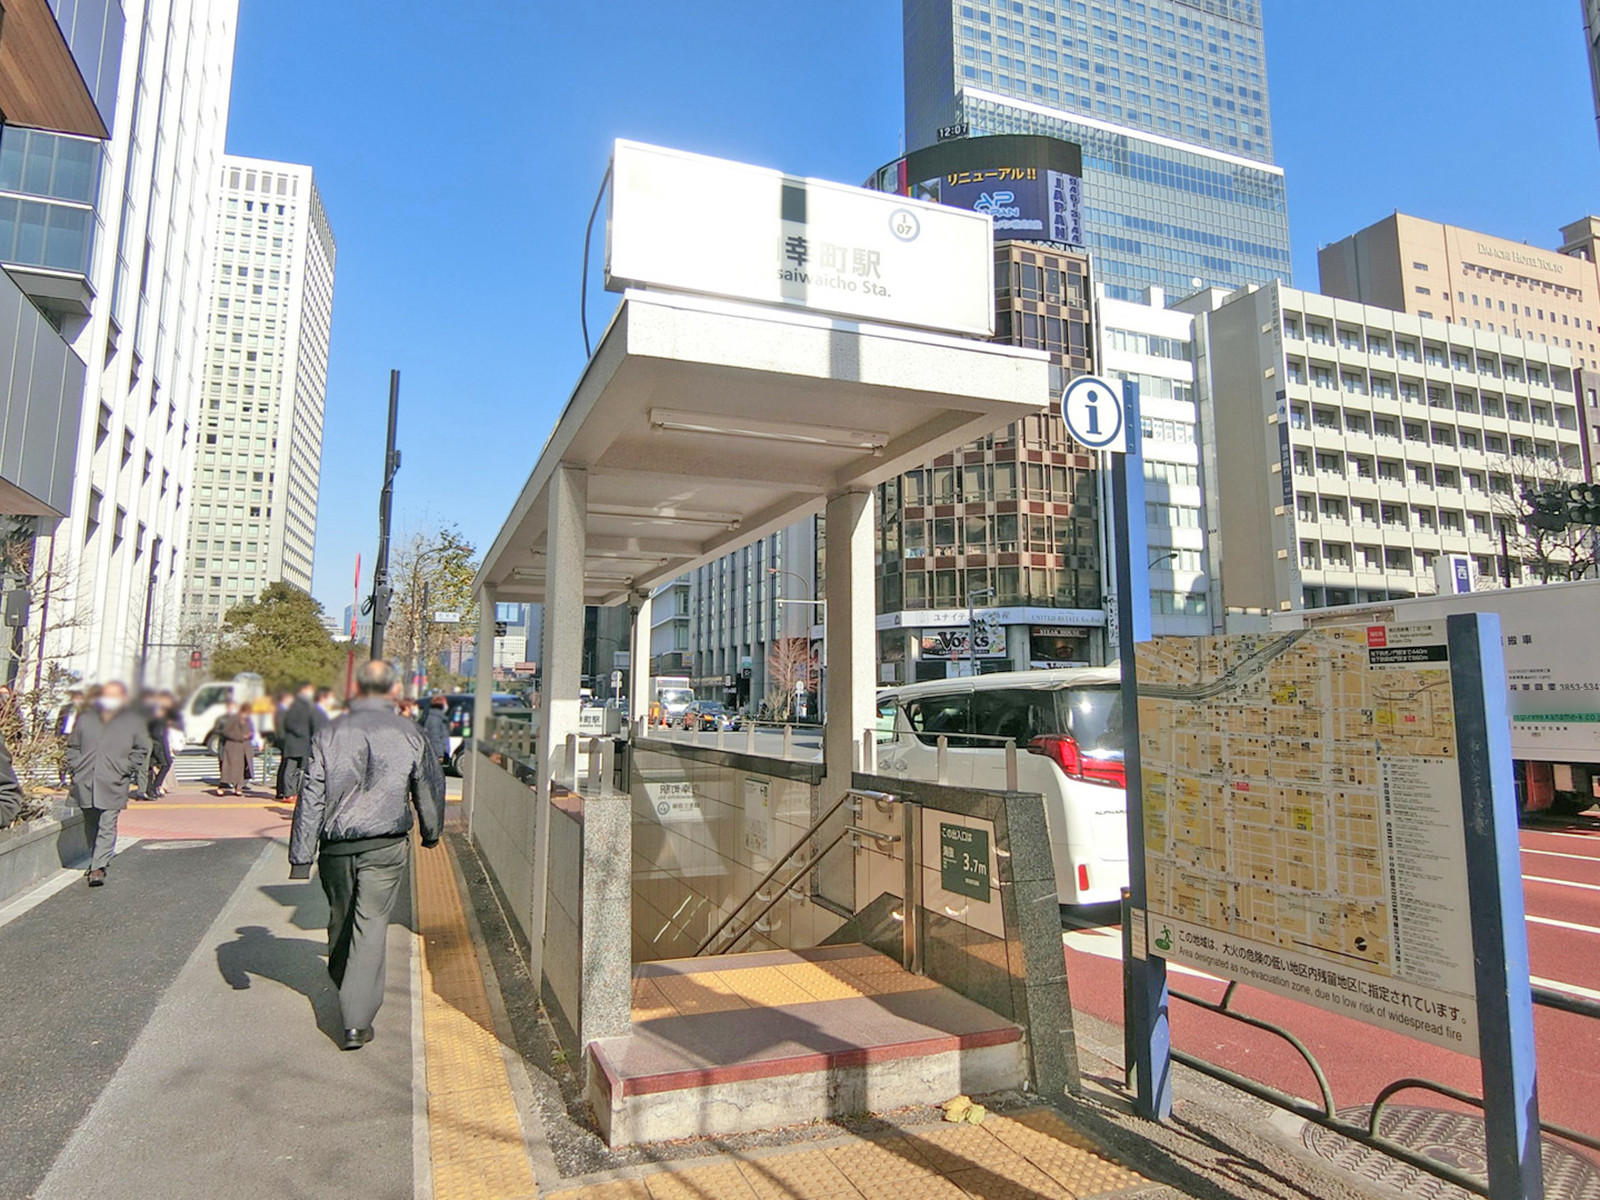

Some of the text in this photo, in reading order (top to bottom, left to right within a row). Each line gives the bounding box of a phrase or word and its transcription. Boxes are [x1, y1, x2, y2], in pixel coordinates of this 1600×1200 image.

[939, 124, 968, 138] 12:07
[978, 206, 1020, 218] APAN
[897, 223, 912, 236] 07
[777, 235, 881, 280] 幸町駅
[863, 280, 892, 298] Sta.
[1559, 682, 1600, 691] 3853-534
[962, 853, 987, 875] 3.7m
[1178, 947, 1463, 1042] Area designated as no-evacuation zone, due to low risk of widespread fire
